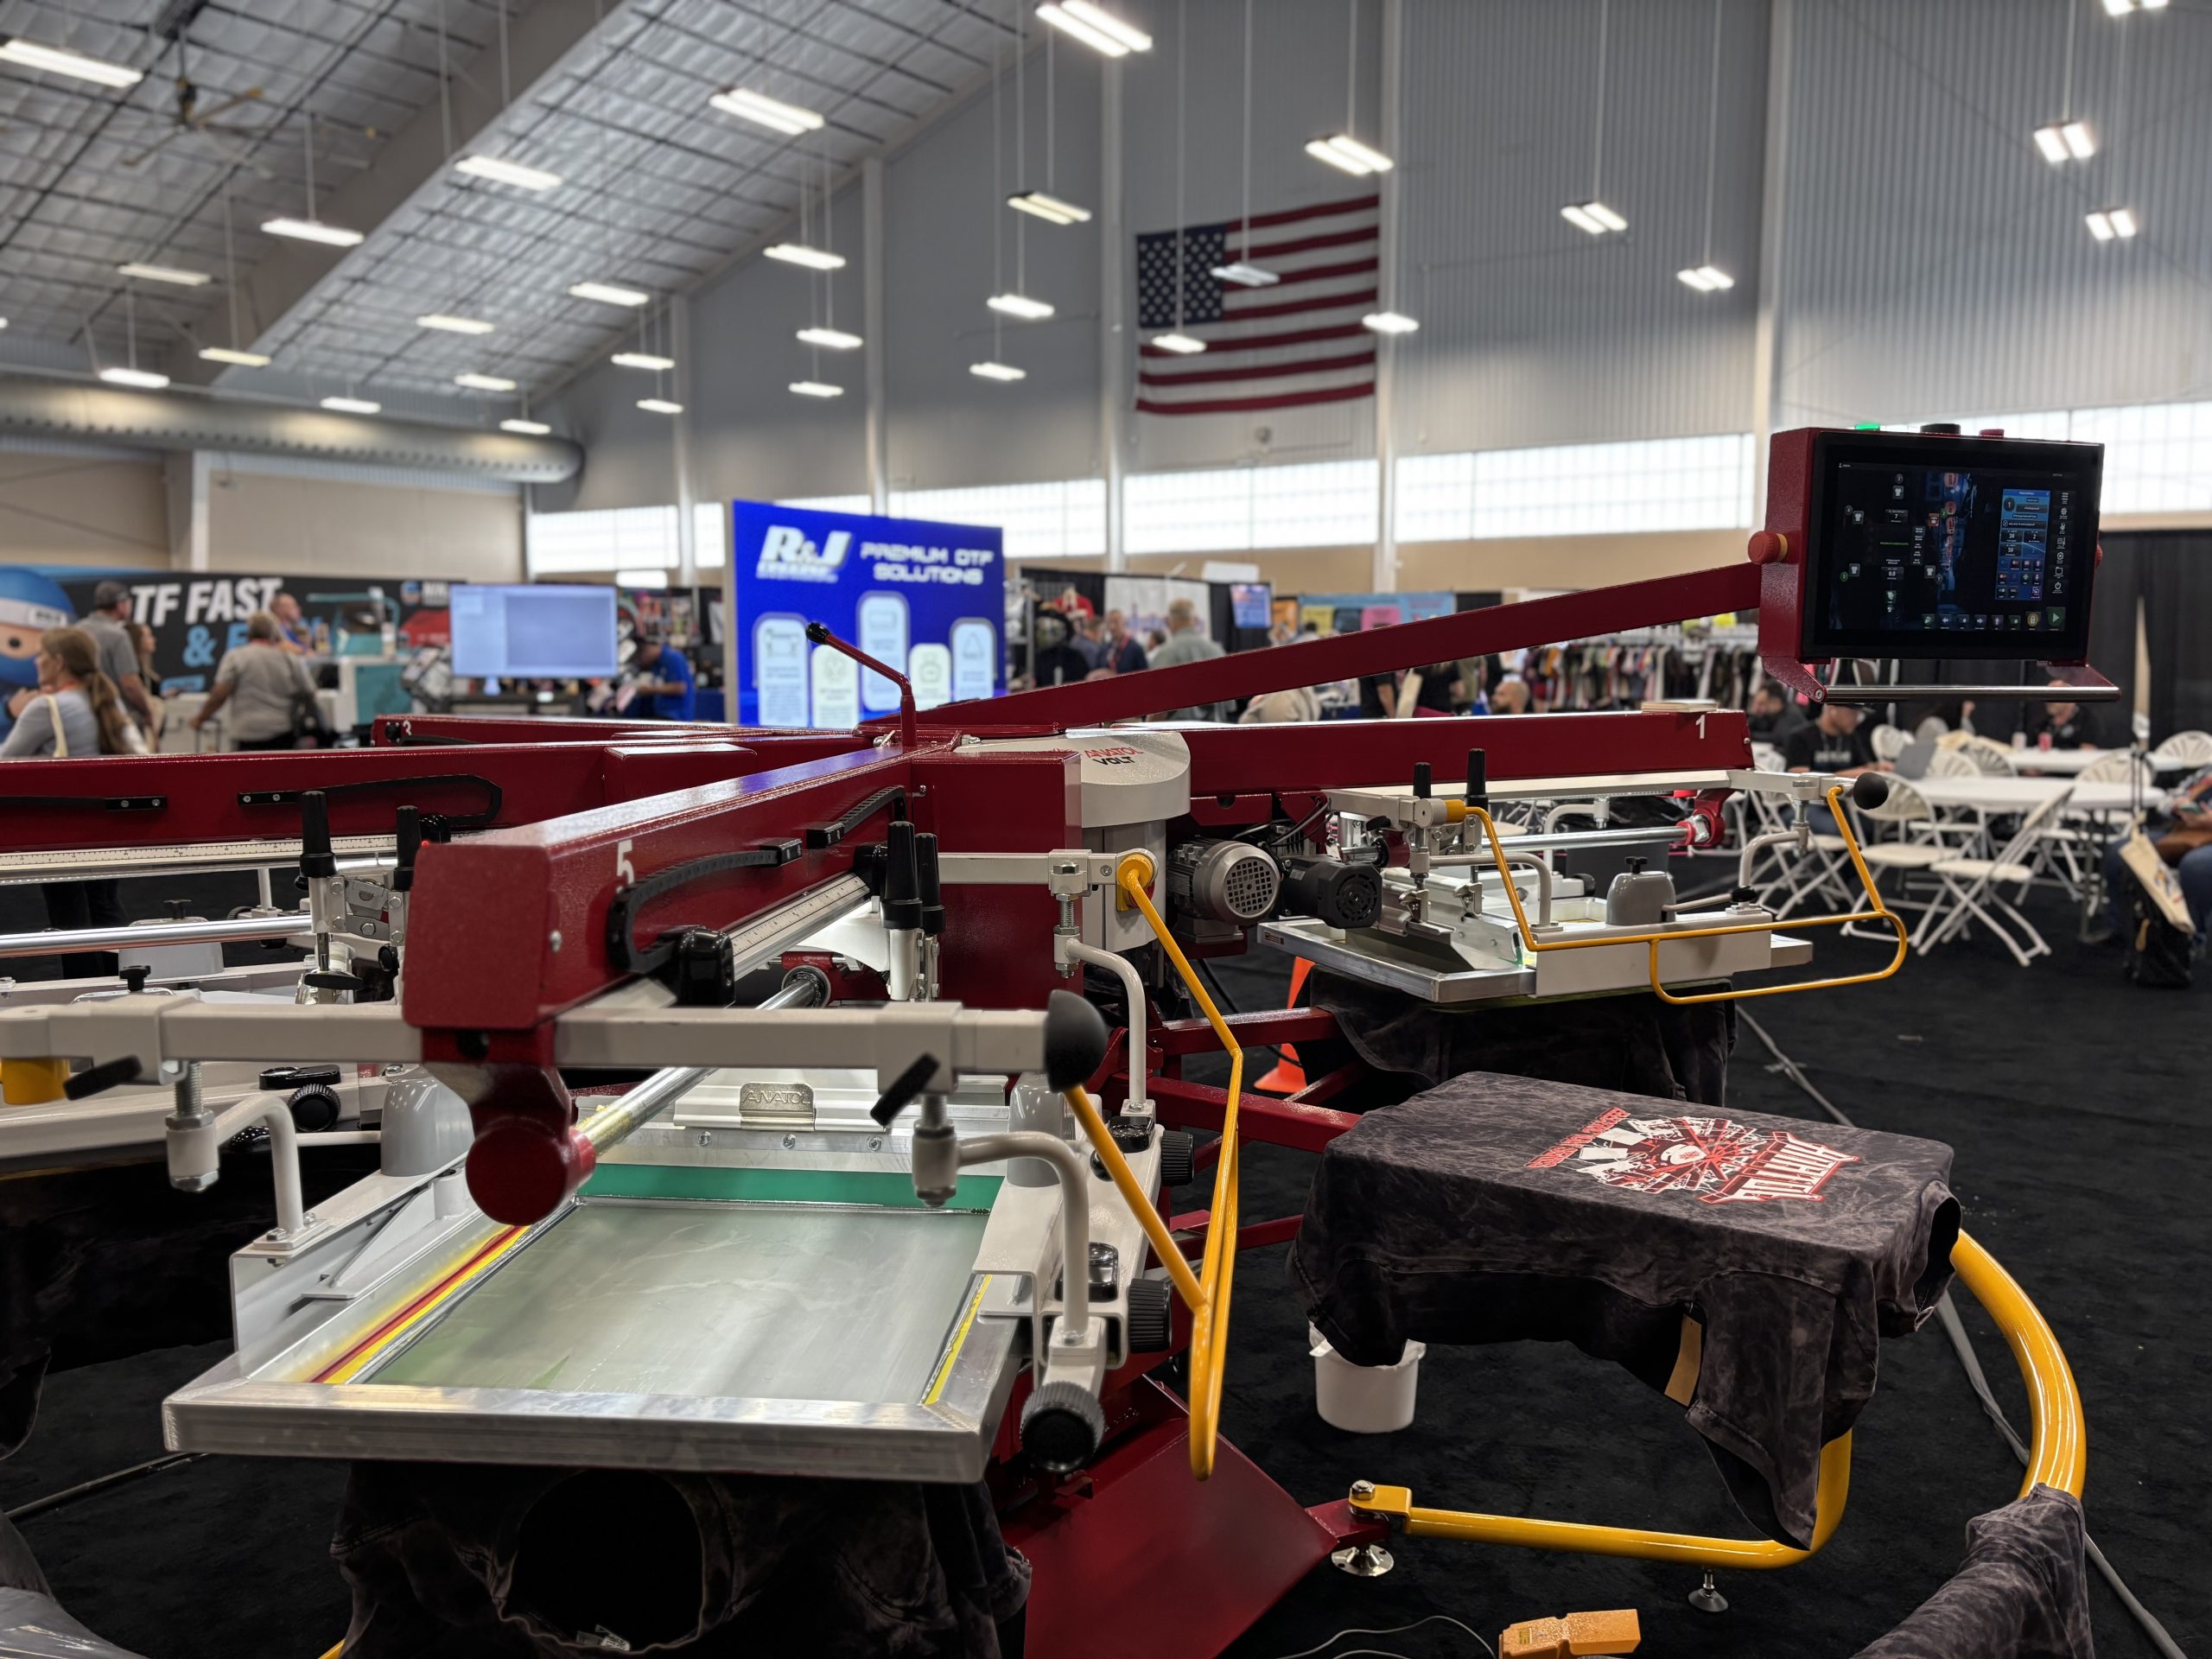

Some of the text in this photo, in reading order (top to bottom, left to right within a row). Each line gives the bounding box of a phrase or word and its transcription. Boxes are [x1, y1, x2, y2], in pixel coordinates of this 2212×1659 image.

[861, 542, 948, 563] PREMIUM
[874, 564, 983, 584] SOLUTIONS
[130, 577, 283, 626] TF FAST
[182, 625, 216, 668] &
[1695, 714, 1706, 740] 1
[1084, 747, 1144, 758] ANATOL
[1092, 756, 1135, 766] VOLT
[616, 838, 635, 894] 5
[743, 1090, 811, 1104] ANATOL
